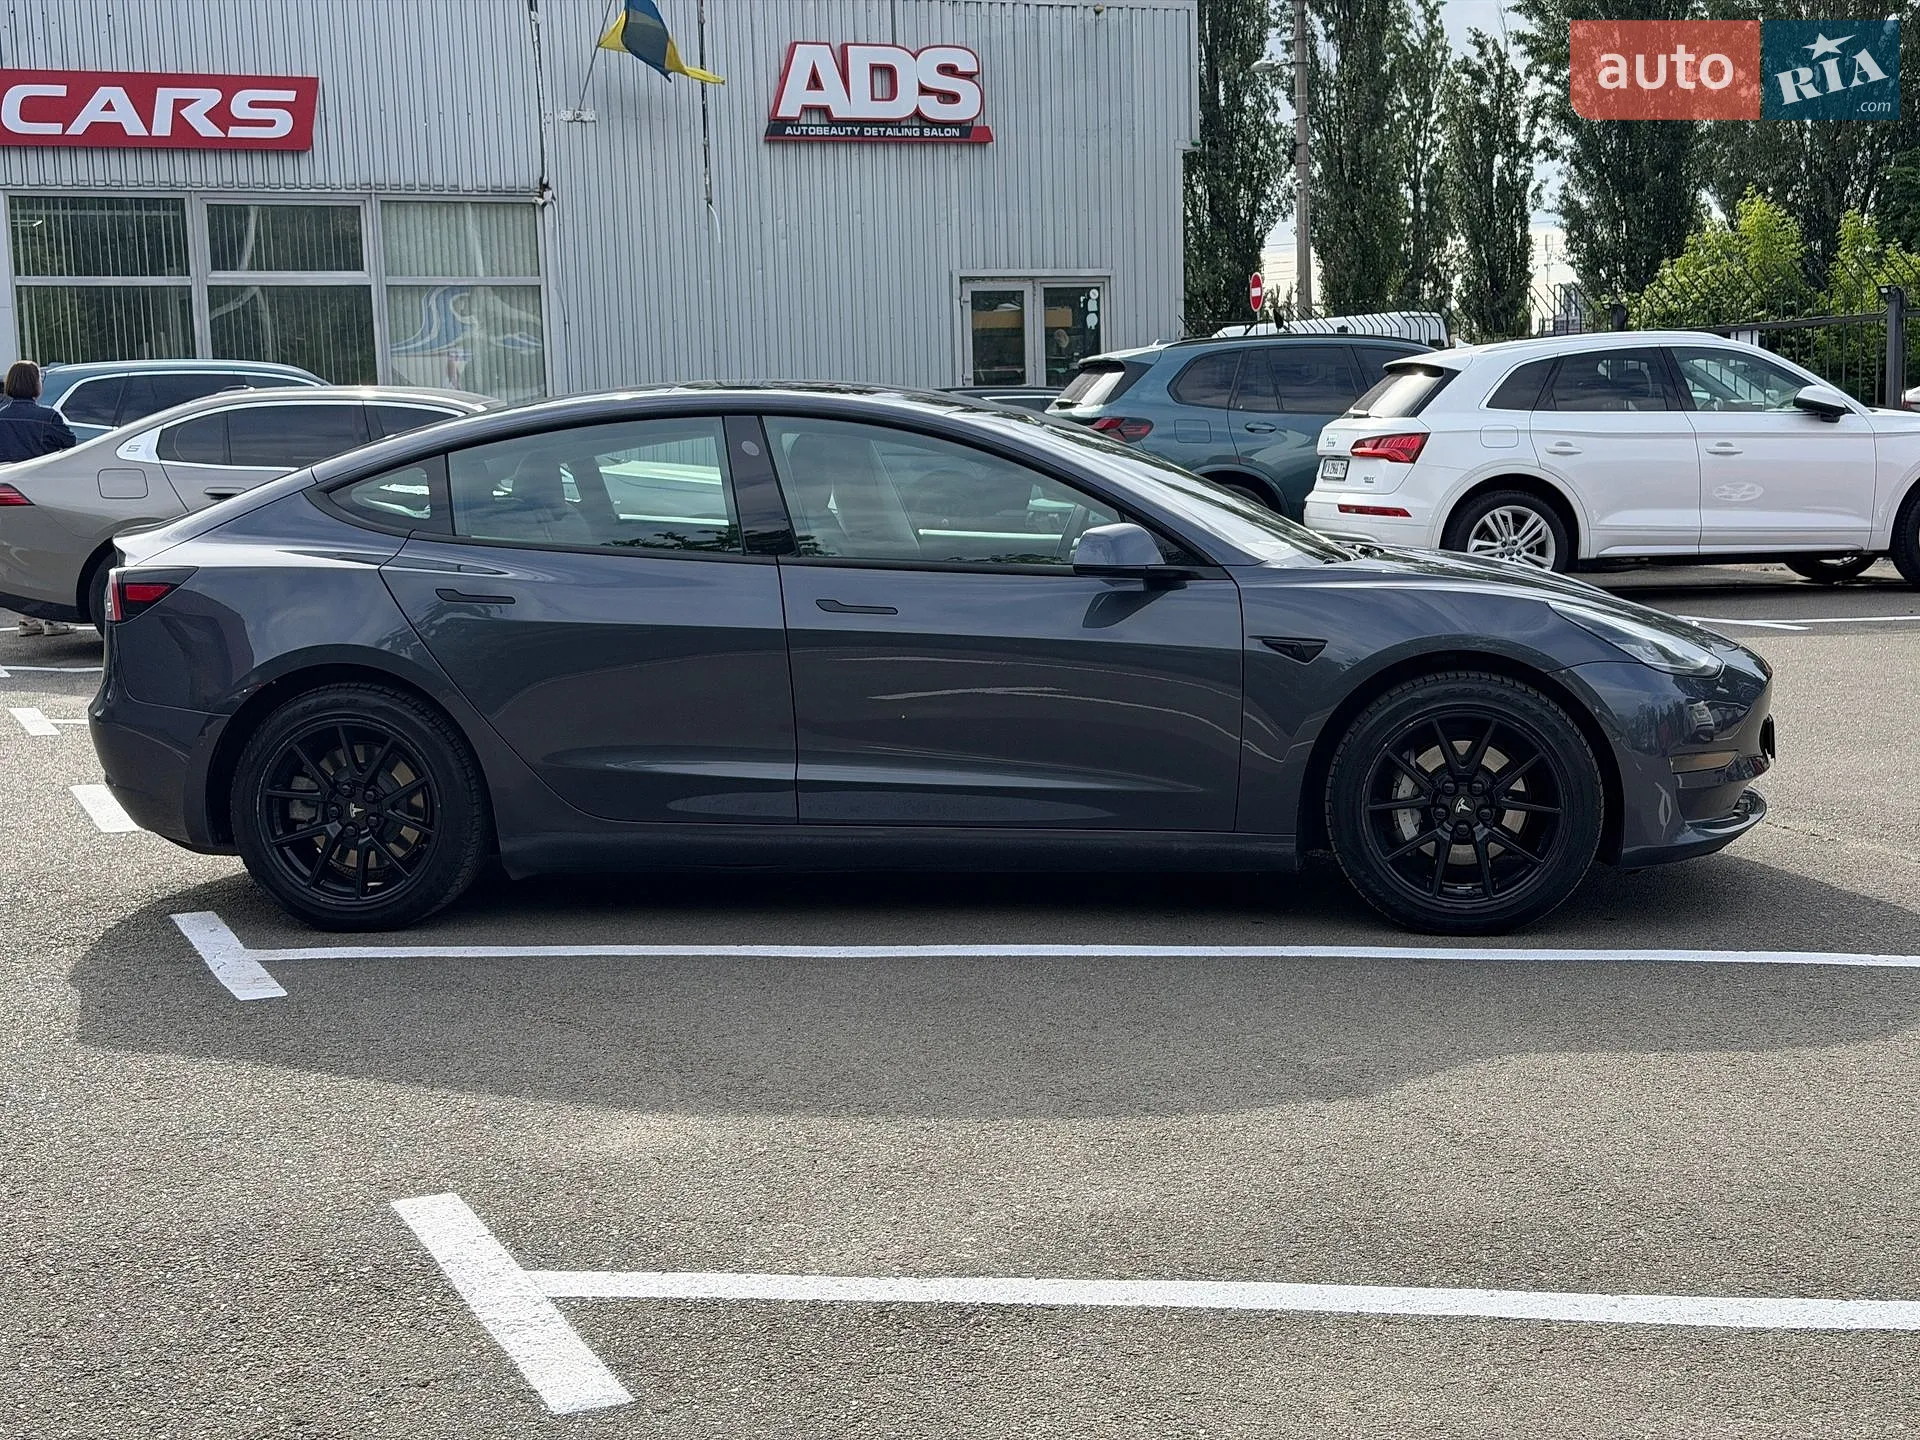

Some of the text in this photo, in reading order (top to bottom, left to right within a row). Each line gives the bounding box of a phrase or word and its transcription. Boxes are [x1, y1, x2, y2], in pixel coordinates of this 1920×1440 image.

[775, 43, 983, 122] ADS
[1, 84, 296, 139] CARS
[785, 126, 960, 137] AUTOBEAUTY DETAILING SALON
